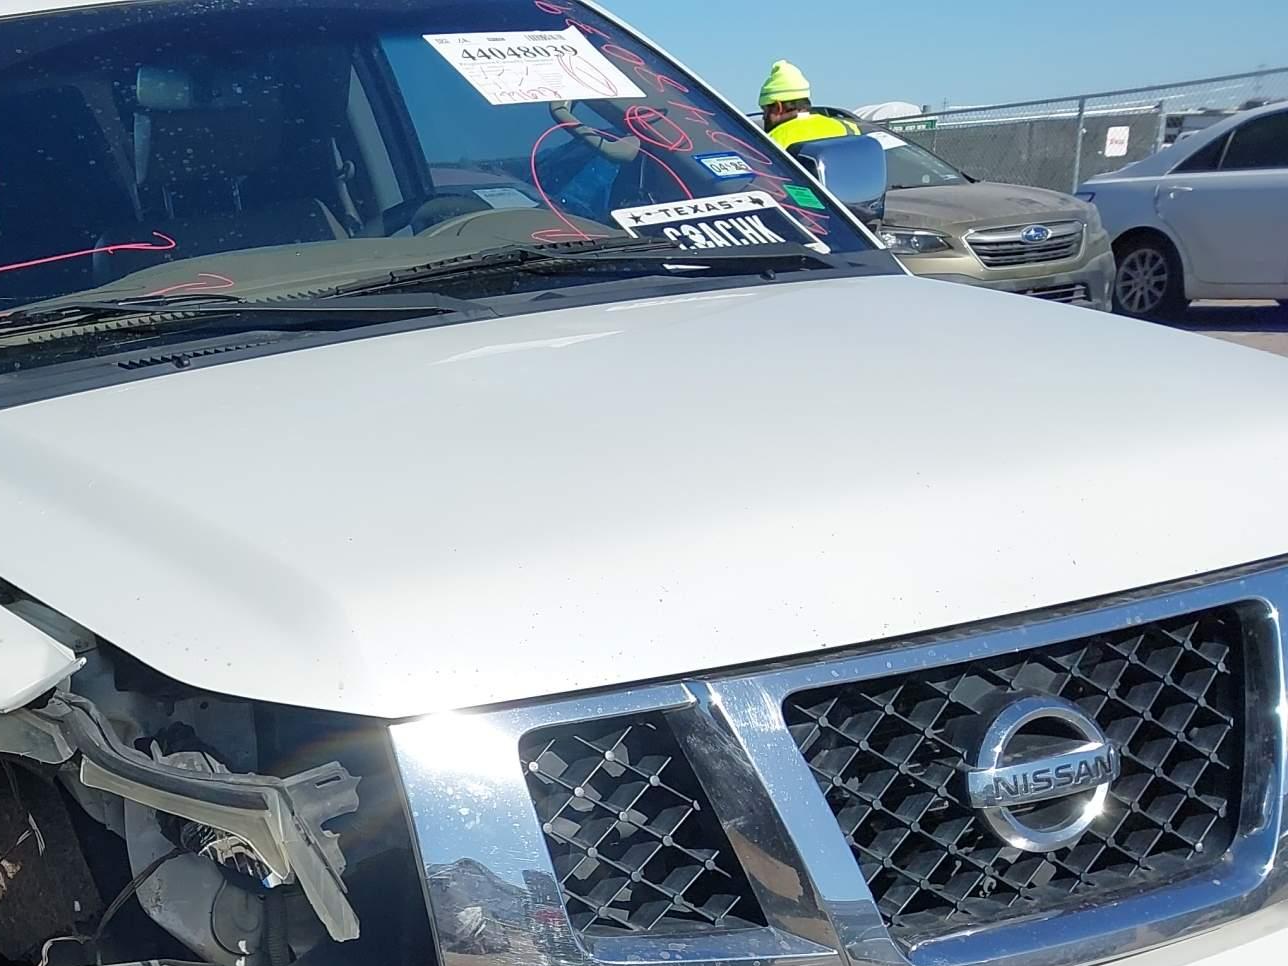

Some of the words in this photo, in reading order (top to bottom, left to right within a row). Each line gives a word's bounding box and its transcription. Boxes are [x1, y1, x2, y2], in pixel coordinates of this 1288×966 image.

[461, 44, 578, 61] 44048039
[658, 200, 734, 218] TEXAS
[992, 755, 1113, 800] NISSAN
